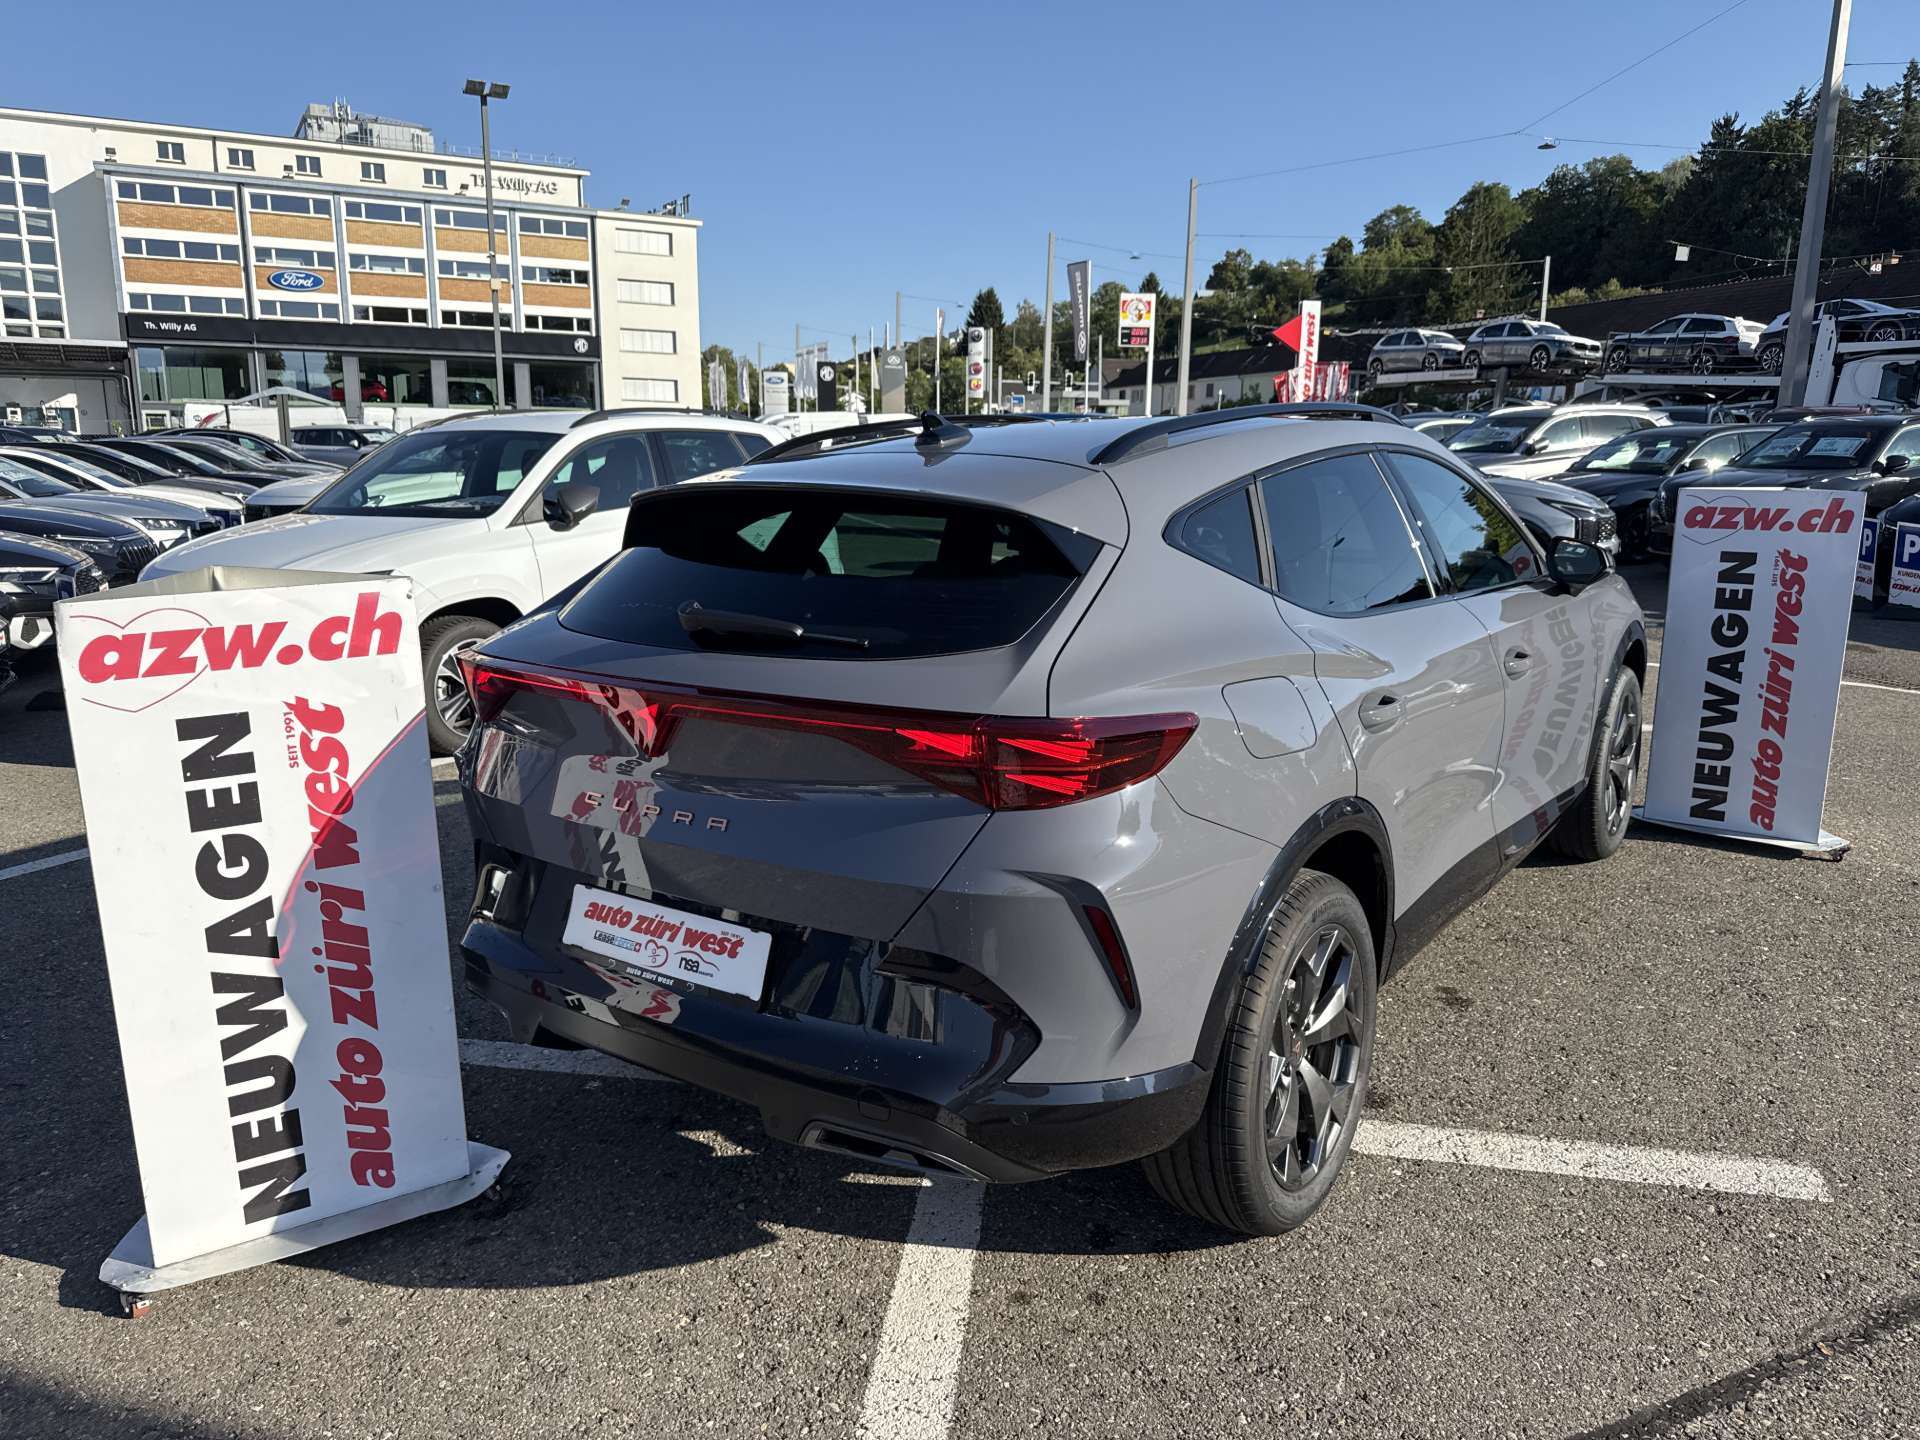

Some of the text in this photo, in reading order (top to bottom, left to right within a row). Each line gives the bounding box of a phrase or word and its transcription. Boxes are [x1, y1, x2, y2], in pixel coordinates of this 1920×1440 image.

[497, 176, 531, 195] Willy
[535, 180, 557, 195] AG
[281, 272, 313, 288] Ford
[1870, 263, 1882, 272] 48
[143, 320, 197, 333] Th. Willy AG
[1306, 311, 1316, 347] west
[1683, 498, 1855, 533] azw.ch
[1861, 528, 1873, 556] P
[1902, 533, 1920, 563] P
[78, 592, 403, 684] azw.ch
[1689, 550, 1758, 822] NEUWAGEN
[1749, 548, 1808, 831] auto züri west
[283, 711, 299, 768] SEIT 1991
[585, 791, 728, 832] CUPRA
[282, 695, 396, 1189] auto züri west
[584, 902, 745, 959] auto züri west
[175, 711, 311, 1225] NEUWAGEN
[625, 966, 641, 976] auto
[657, 974, 674, 986] west
[678, 956, 700, 973] nsa
